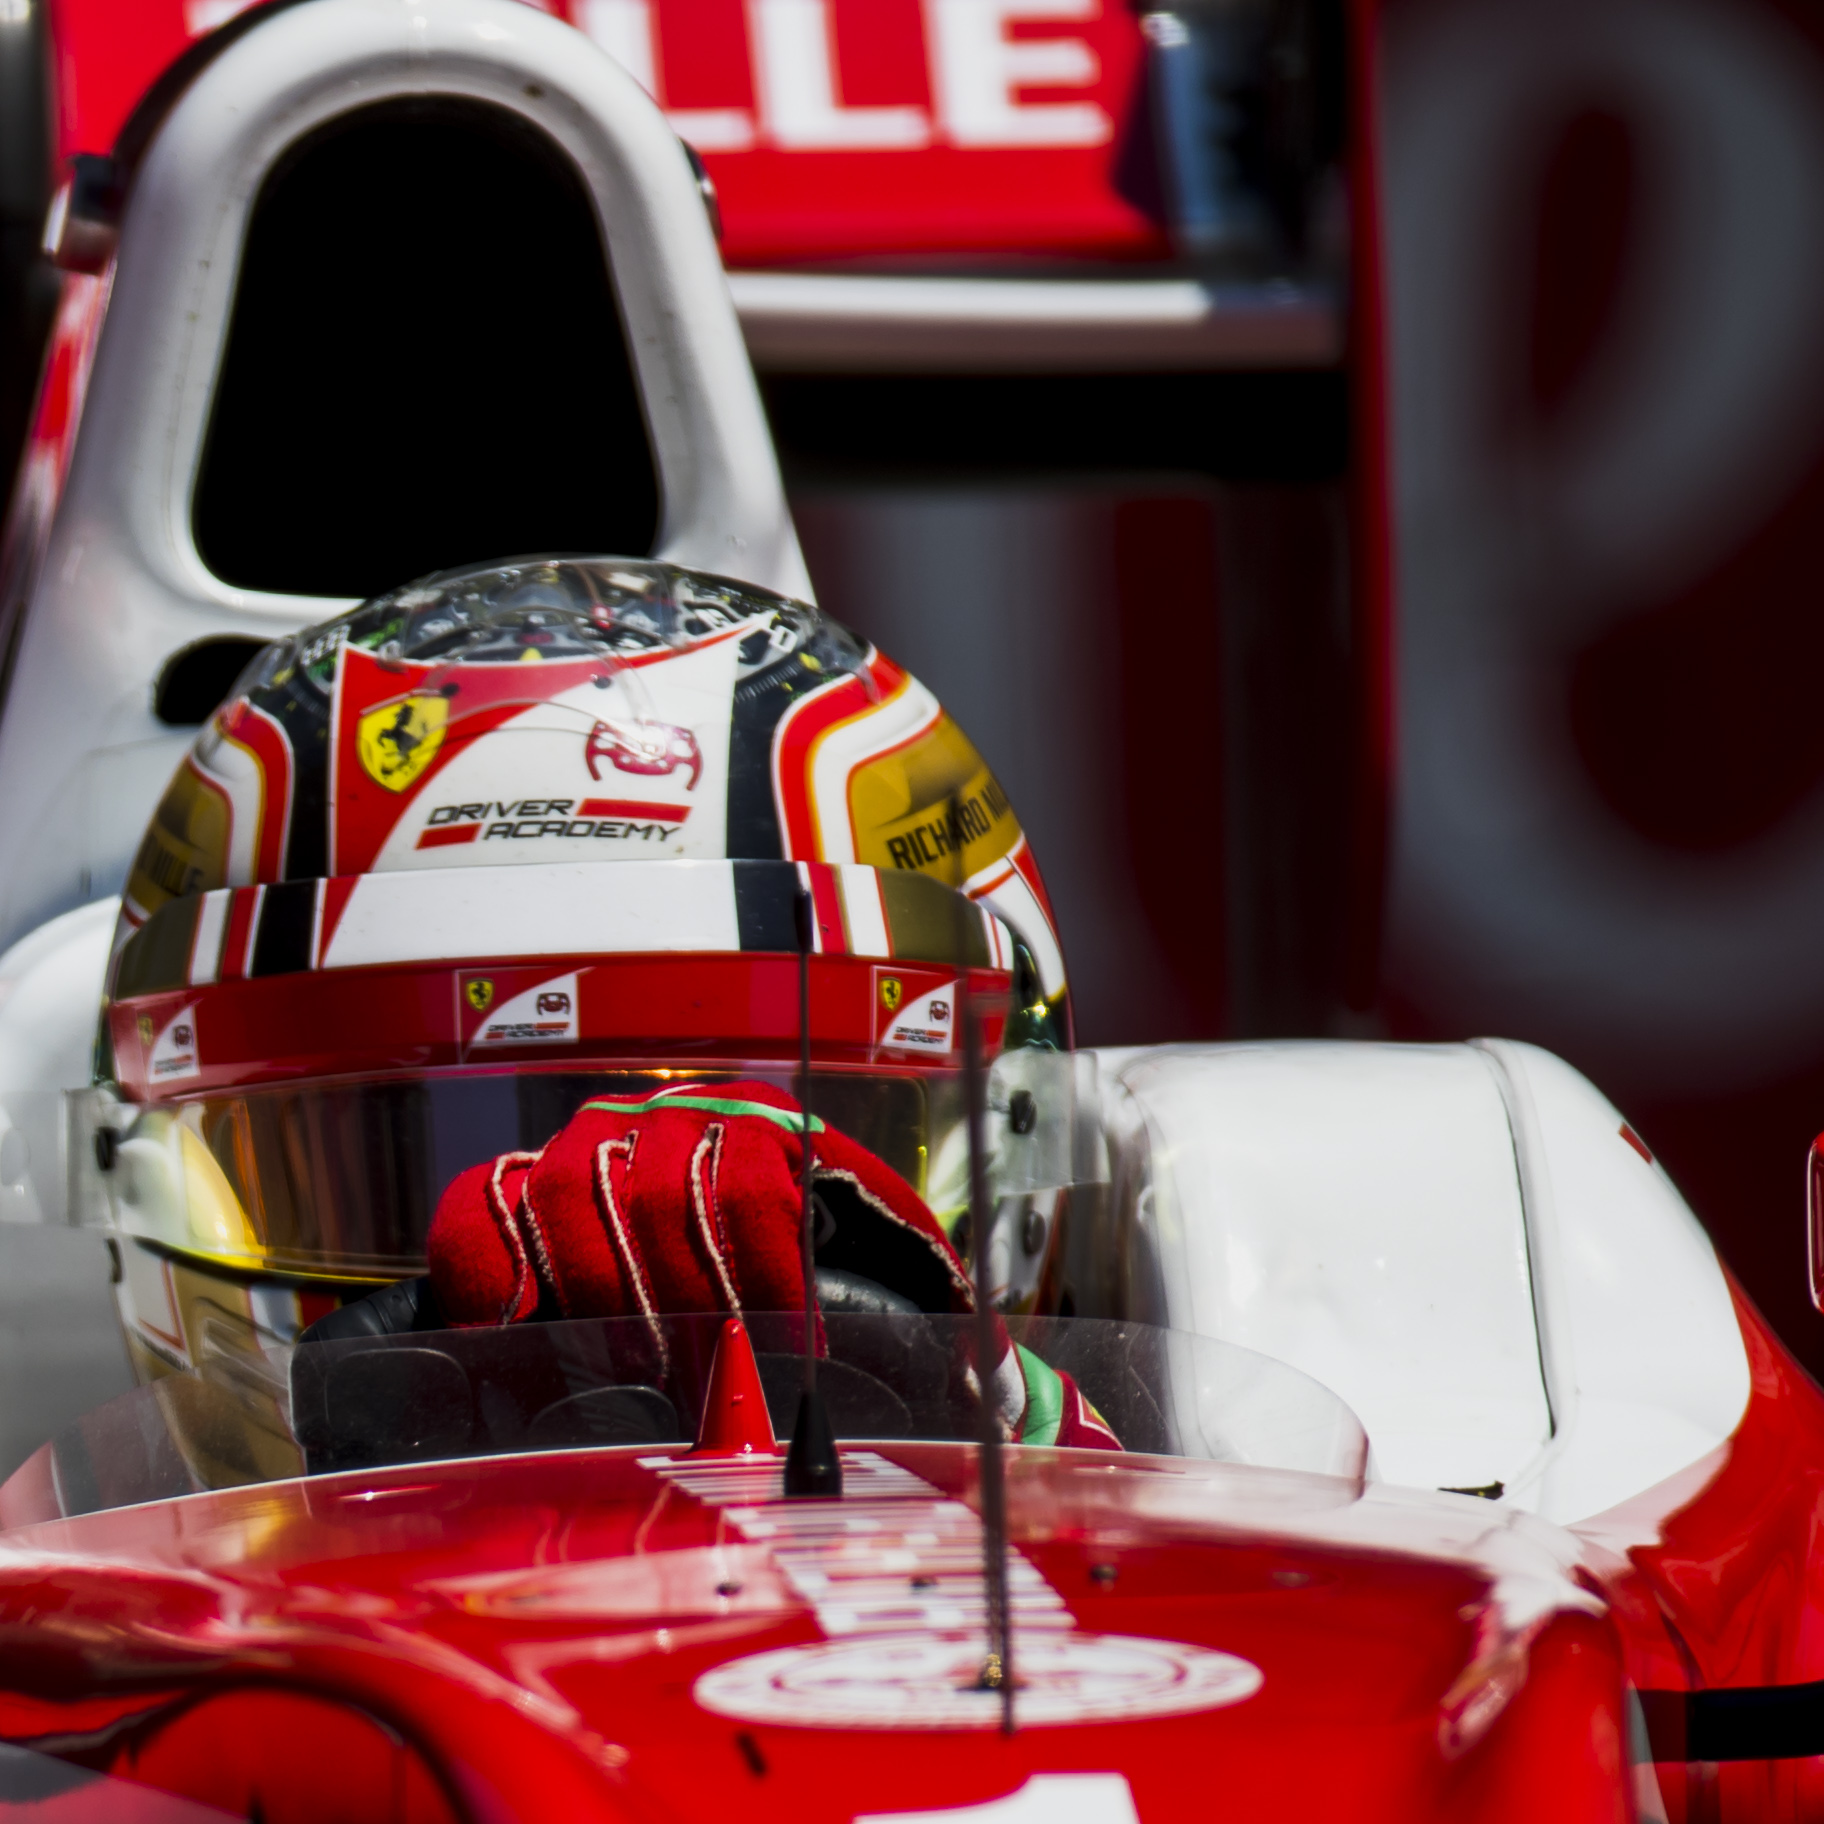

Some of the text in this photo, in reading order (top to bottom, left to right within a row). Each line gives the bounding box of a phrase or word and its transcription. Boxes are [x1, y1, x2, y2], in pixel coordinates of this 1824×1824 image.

[427, 799, 575, 825] DRIVER
[483, 820, 682, 841] ACADEMY
[885, 797, 992, 869] RICHARD
